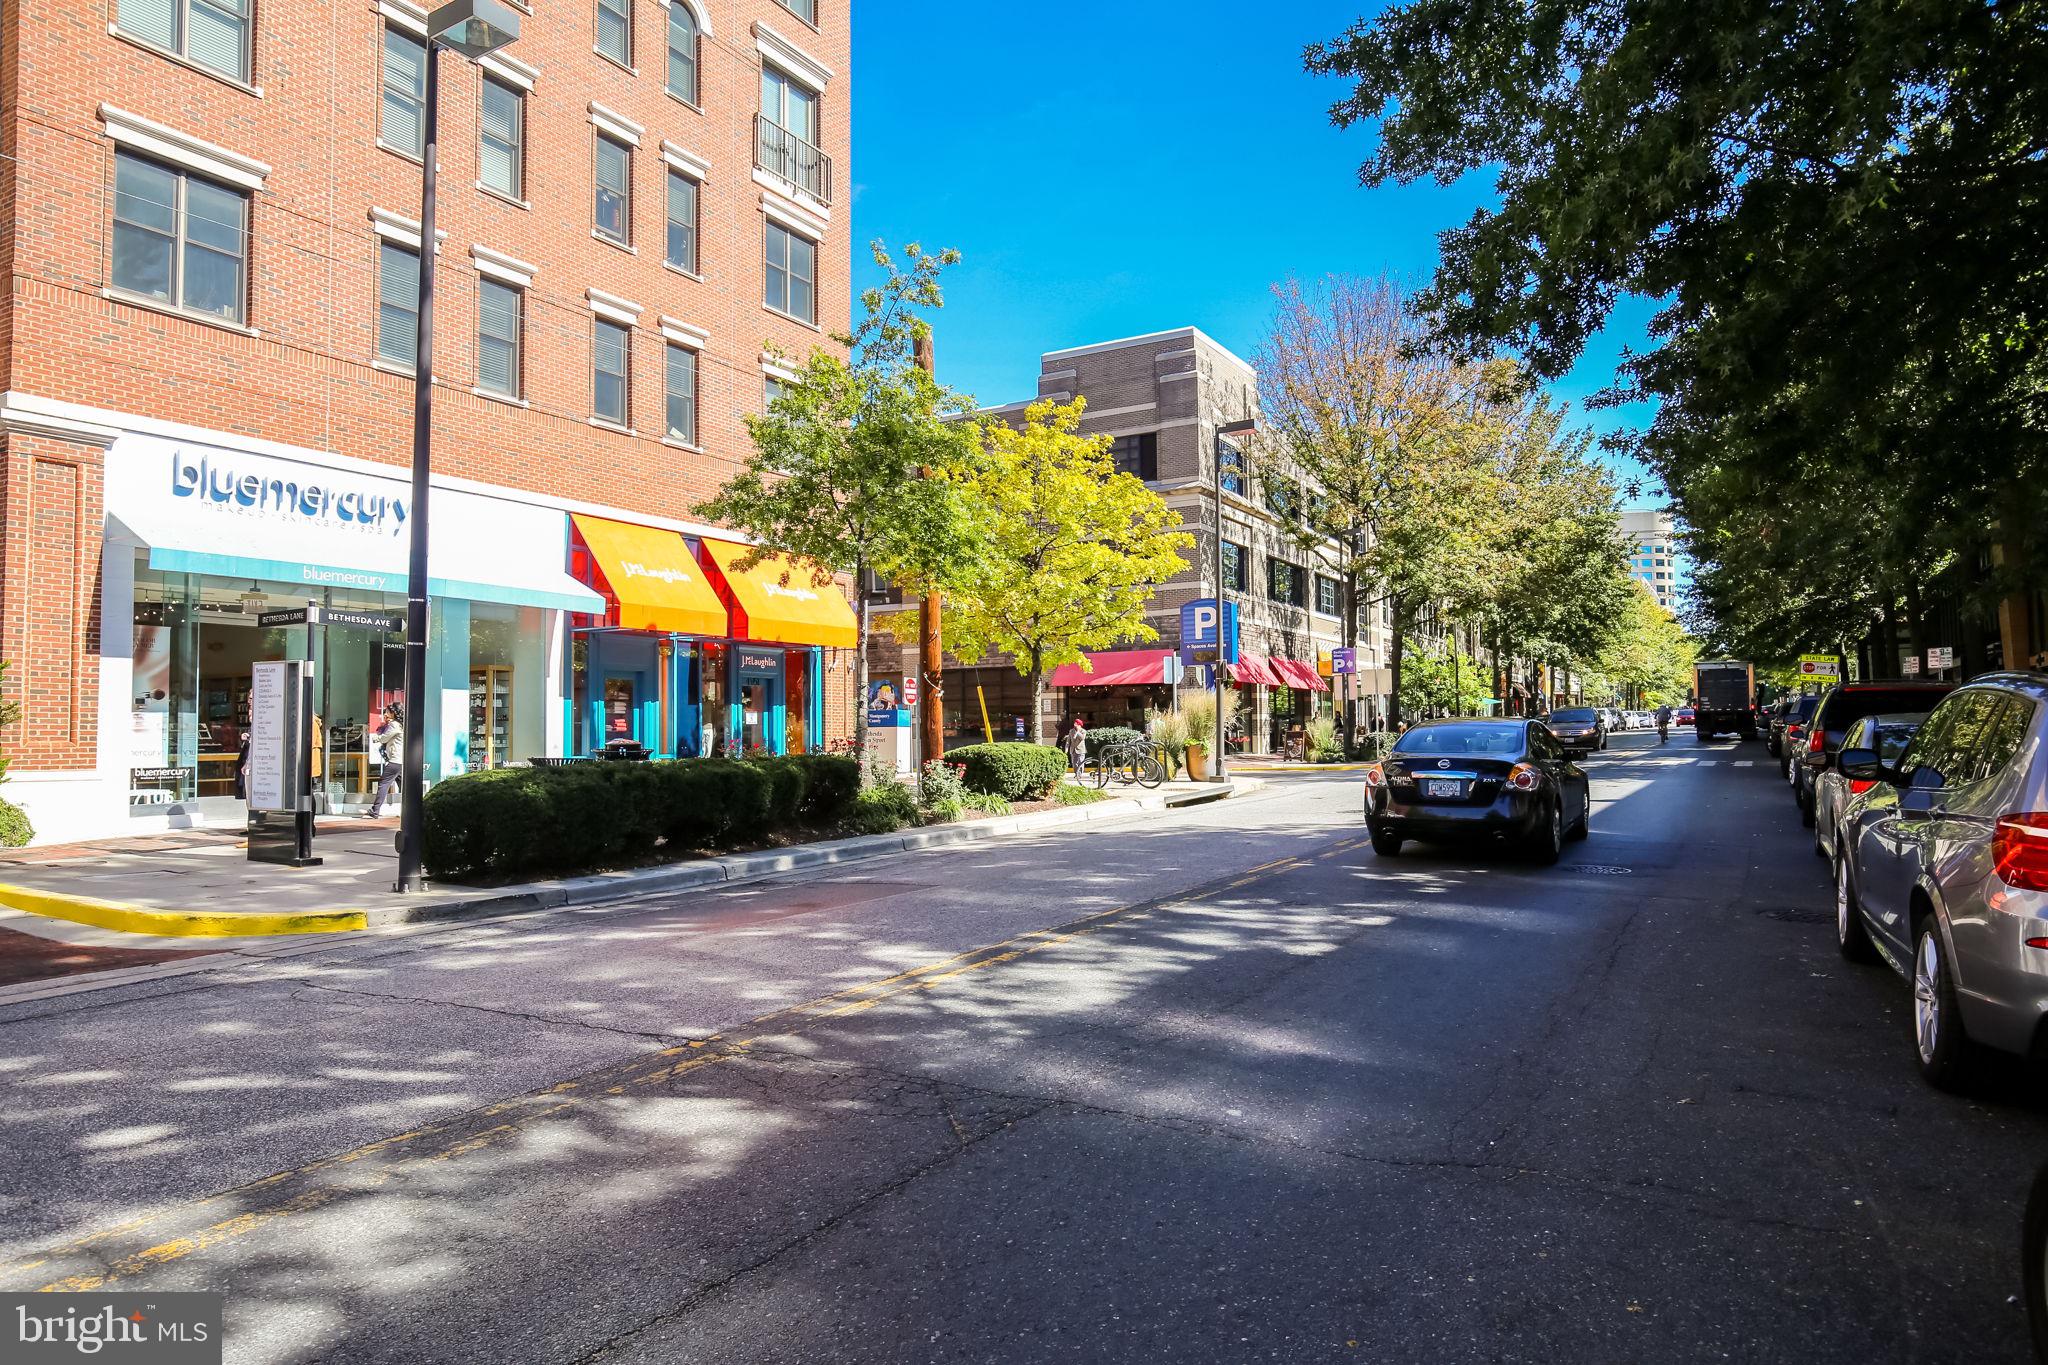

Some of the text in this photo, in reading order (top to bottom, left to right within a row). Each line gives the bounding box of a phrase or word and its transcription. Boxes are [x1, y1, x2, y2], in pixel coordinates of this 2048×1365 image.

[172, 449, 411, 537] bluemercury
[303, 566, 386, 588] bluemercury
[328, 613, 391, 627] BETHESDA AVE
[1194, 606, 1217, 640] P
[1334, 659, 1346, 672] P
[135, 768, 190, 777] bluemercury
